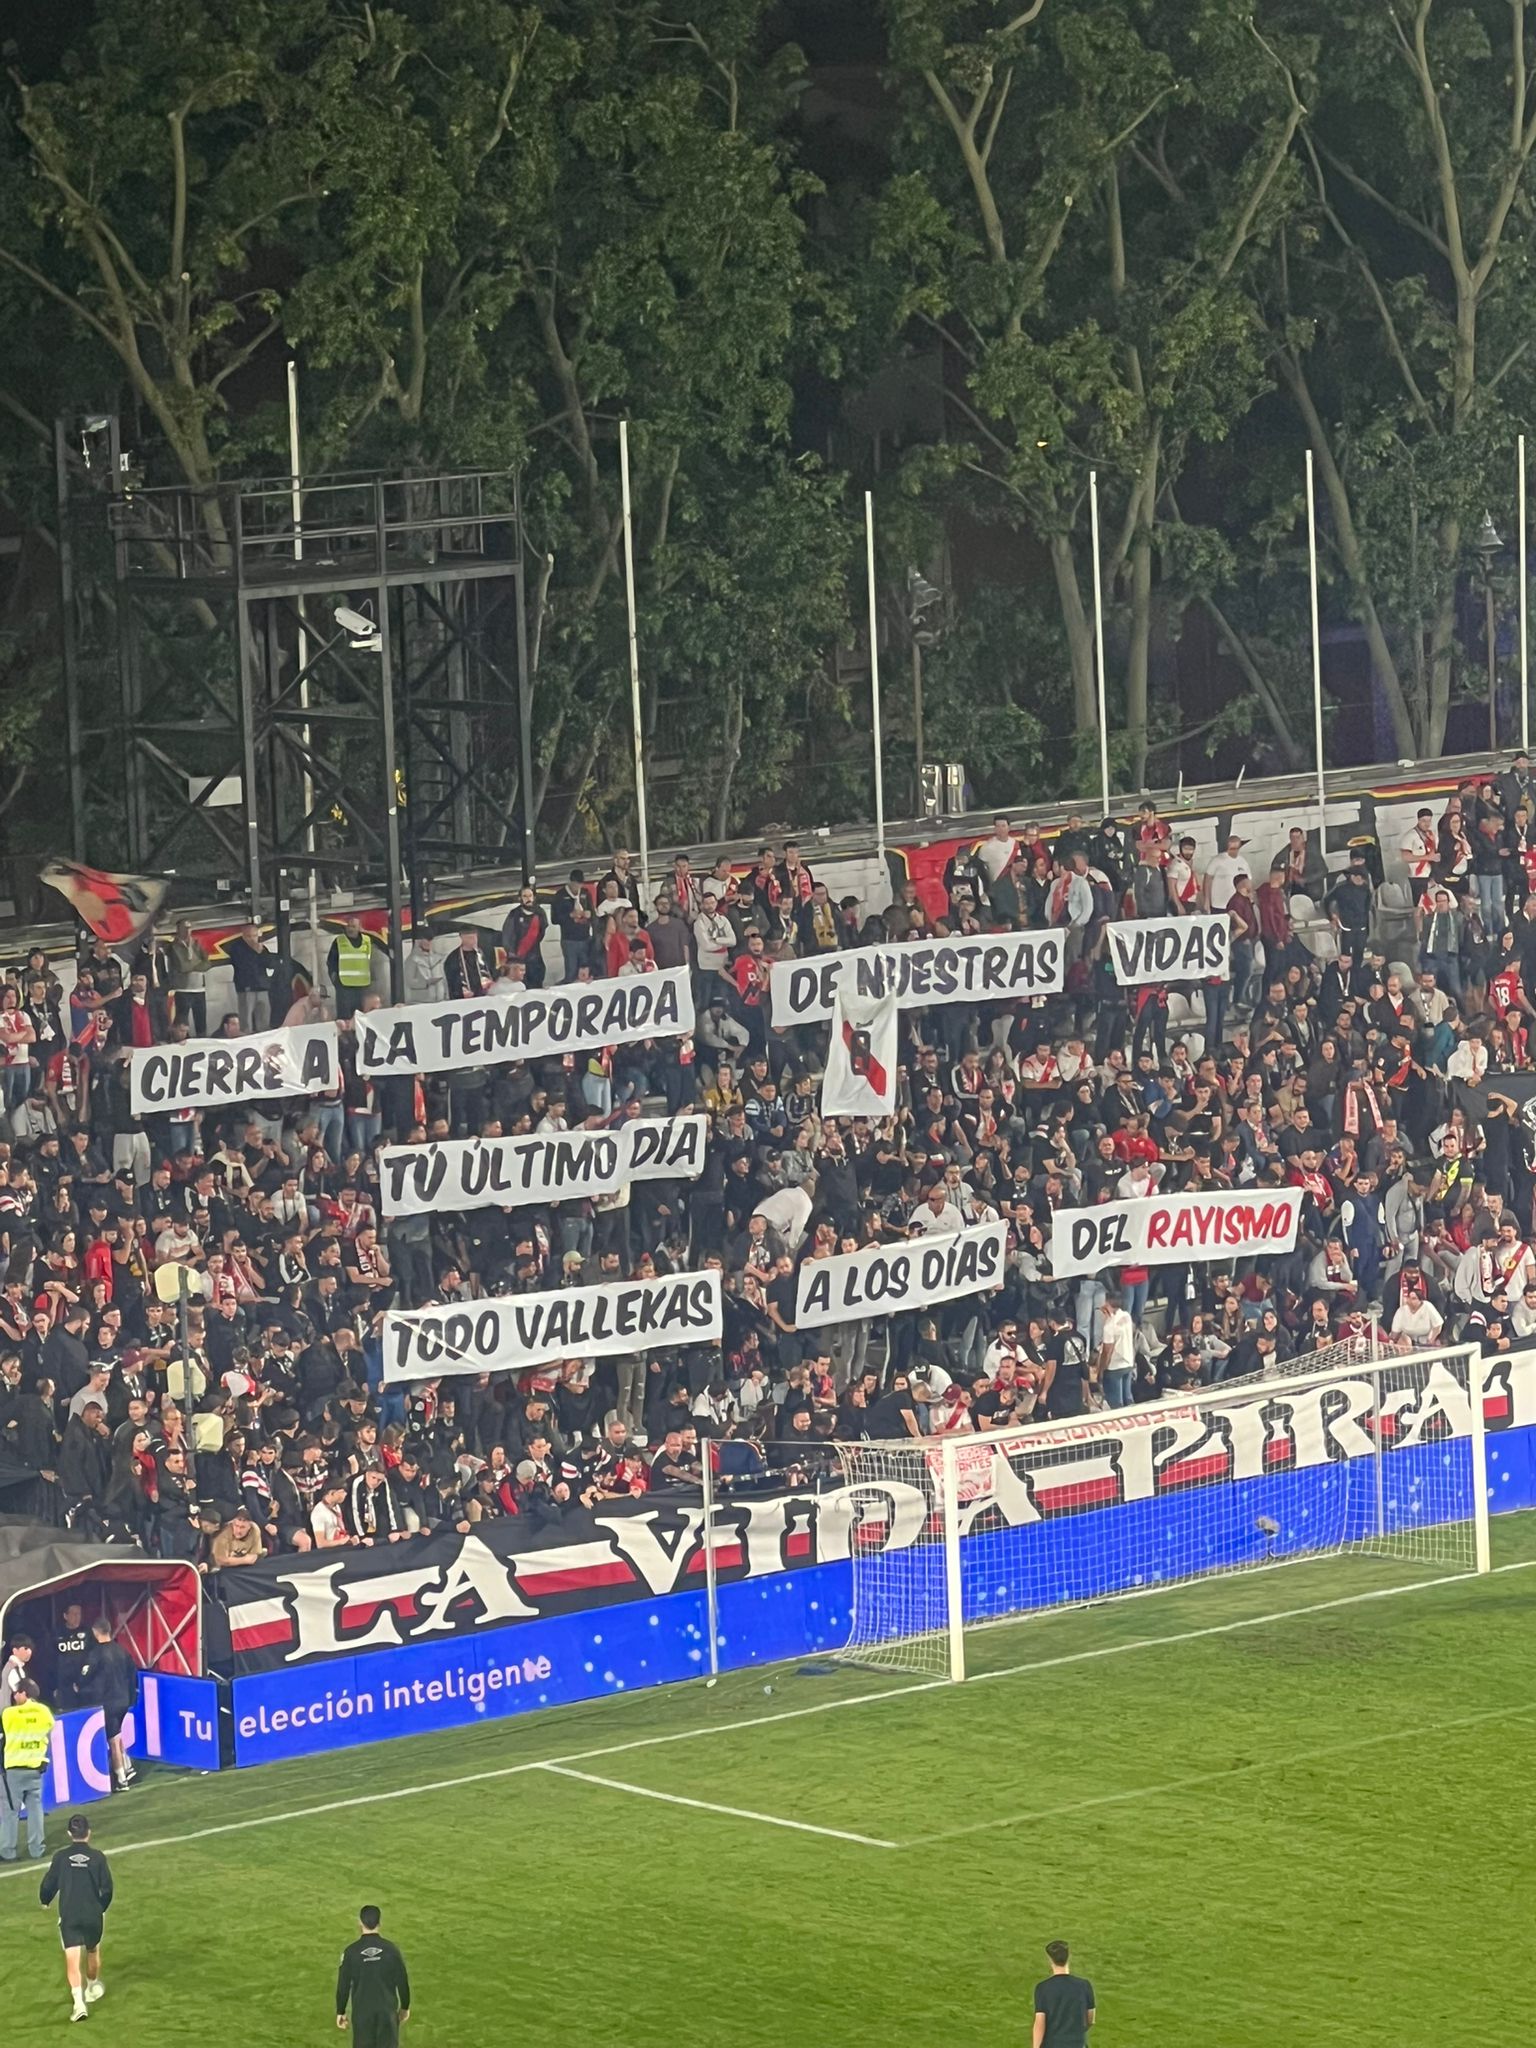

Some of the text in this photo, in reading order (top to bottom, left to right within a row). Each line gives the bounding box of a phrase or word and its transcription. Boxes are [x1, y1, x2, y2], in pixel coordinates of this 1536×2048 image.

[789, 941, 1058, 1012] DE NUESTRAS
[1115, 923, 1226, 977] VIDAS
[363, 981, 678, 1067] LA TEMPORADA
[141, 1040, 330, 1102] CIERRE A
[384, 1118, 698, 1202] TÚ ÚLTIMO DÍA
[1072, 1203, 1292, 1261] DEL RAYISMO
[802, 1234, 1000, 1314] A LOS DÍAS
[391, 1281, 713, 1368] TODO VALLEKAS
[277, 1535, 540, 1662] LA
[179, 1710, 212, 1741] Tu
[239, 1689, 374, 1739] elección
[383, 1655, 553, 1706] inteligente
